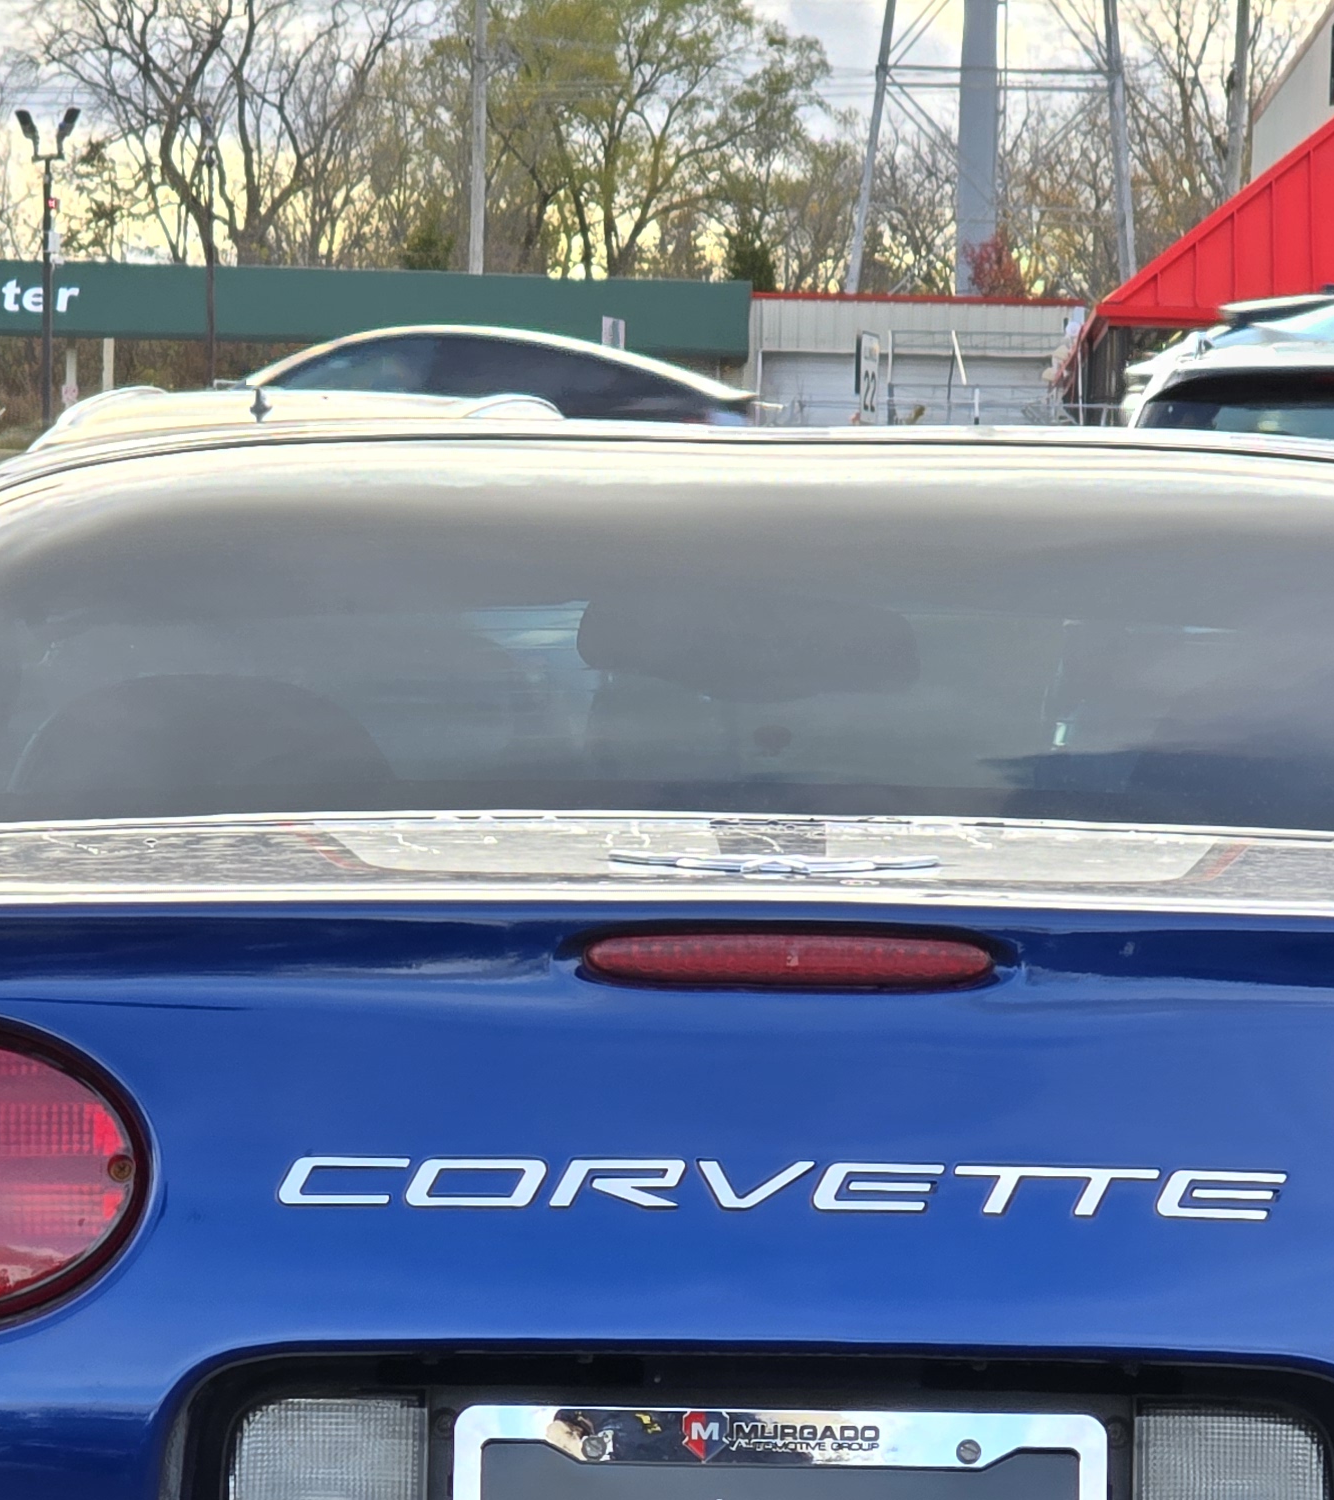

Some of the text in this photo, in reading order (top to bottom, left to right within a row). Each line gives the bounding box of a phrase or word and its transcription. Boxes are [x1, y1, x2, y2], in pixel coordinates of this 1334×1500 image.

[863, 369, 877, 412] 22
[277, 1155, 1289, 1220] CORVETTE
[733, 1422, 880, 1442] MURGADO
[830, 1442, 880, 1452] GROUP
